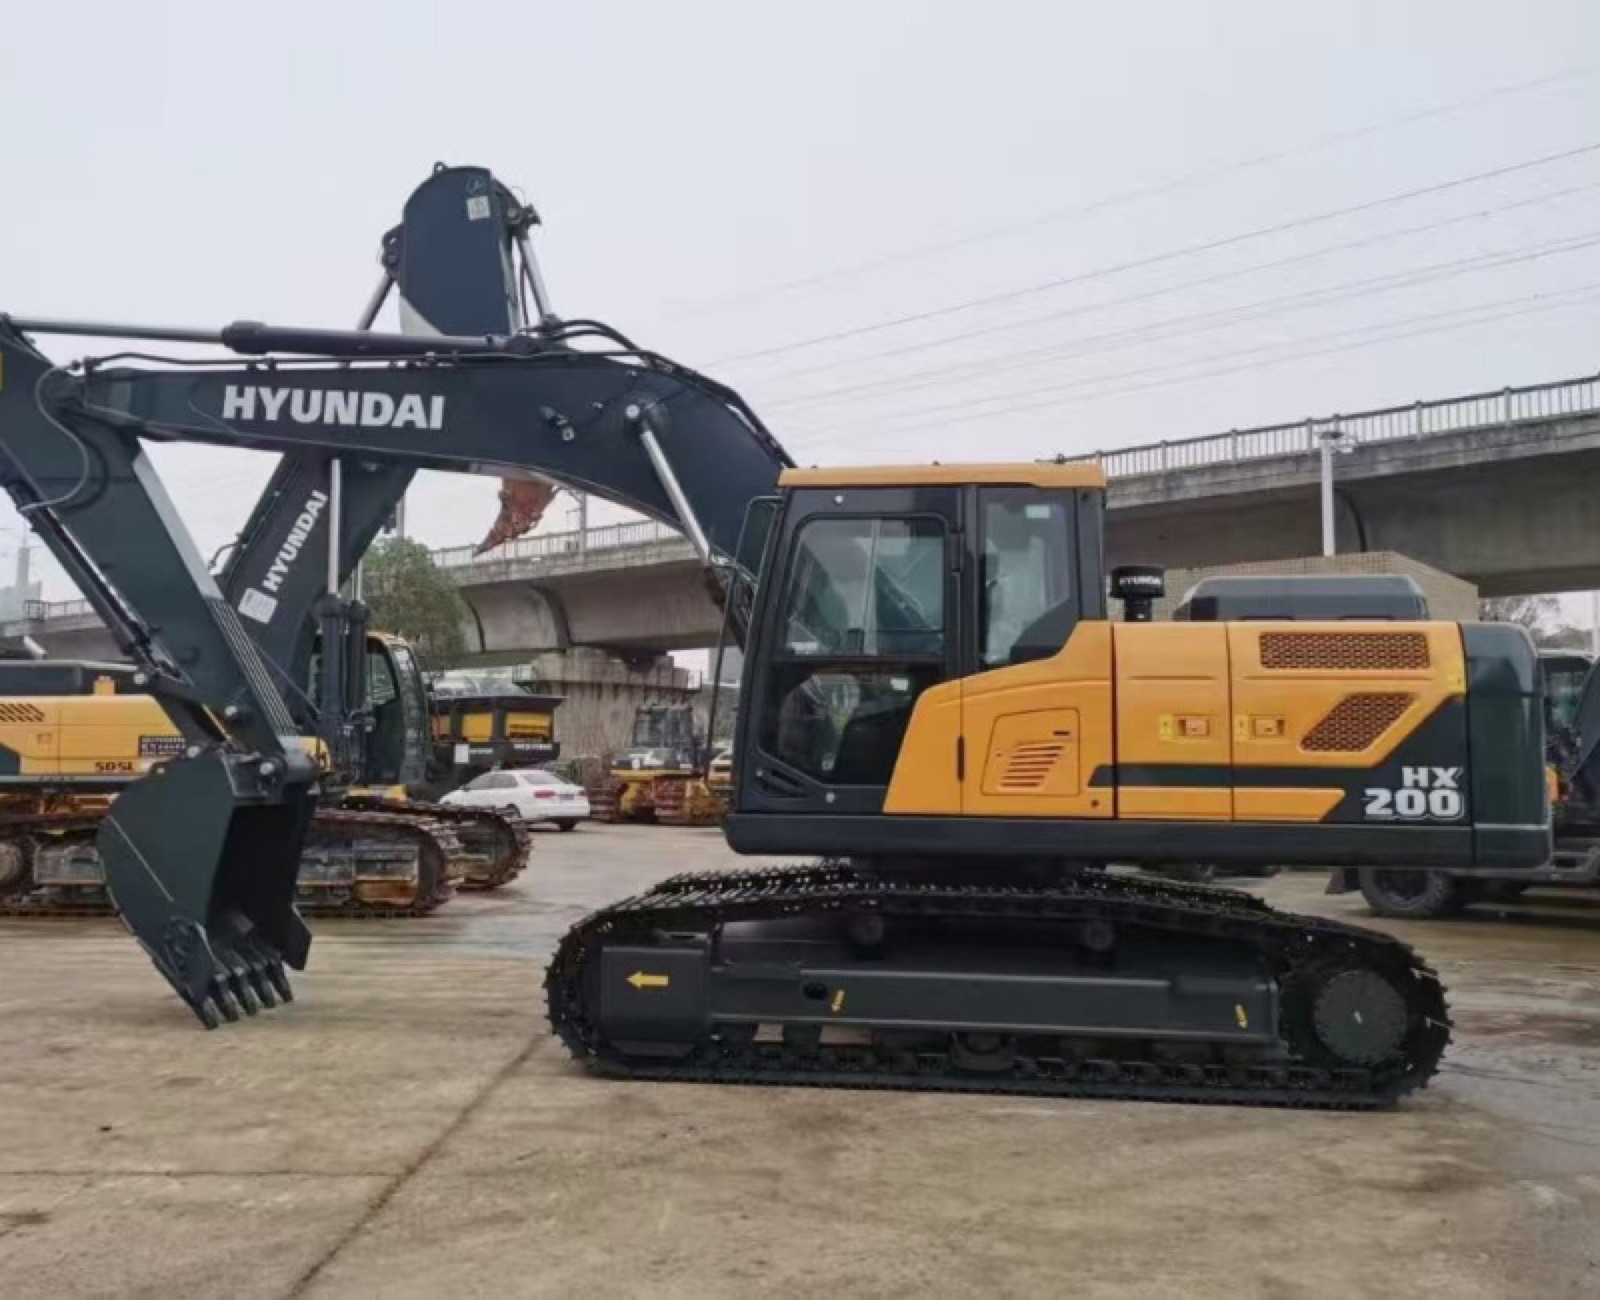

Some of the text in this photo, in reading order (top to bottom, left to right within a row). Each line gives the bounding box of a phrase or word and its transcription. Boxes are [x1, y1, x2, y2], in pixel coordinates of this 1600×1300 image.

[222, 384, 445, 430] HYUNDAI
[262, 489, 328, 592] HYUNDAI
[1401, 766, 1462, 788] HX
[1363, 787, 1464, 820] 200
